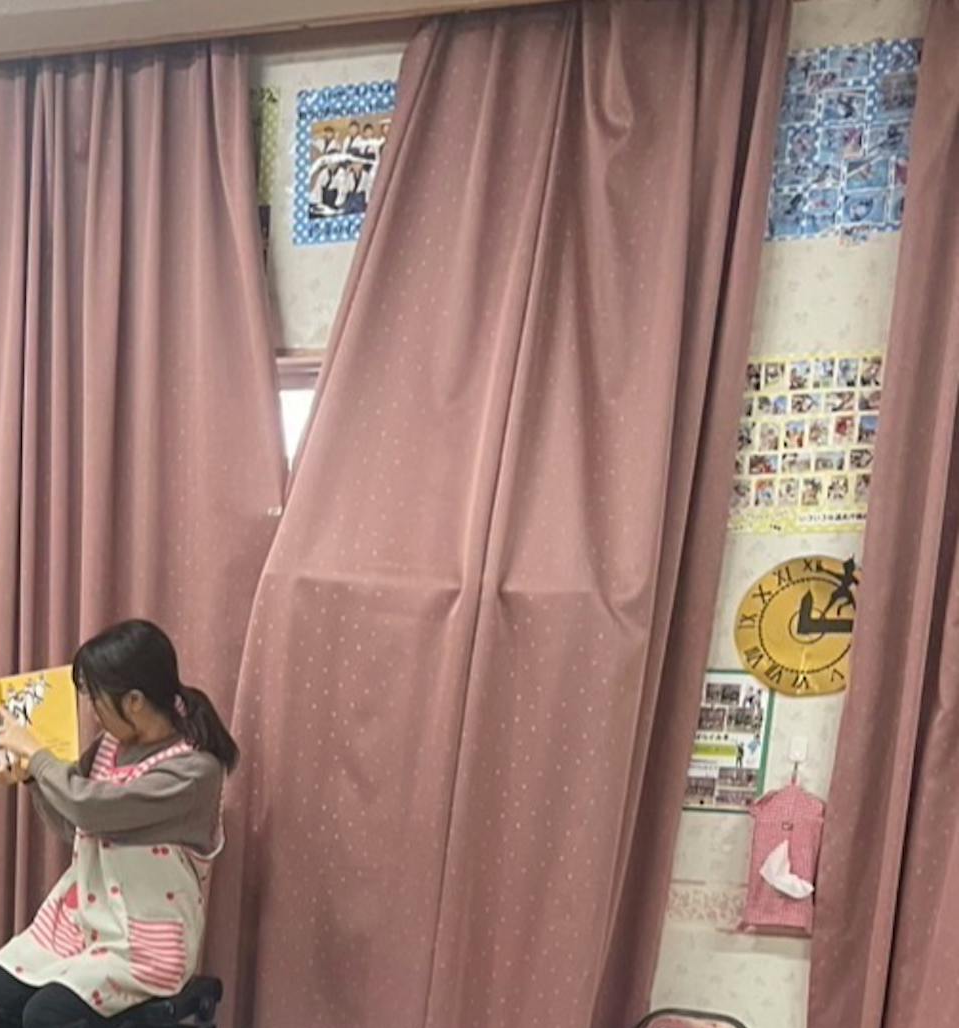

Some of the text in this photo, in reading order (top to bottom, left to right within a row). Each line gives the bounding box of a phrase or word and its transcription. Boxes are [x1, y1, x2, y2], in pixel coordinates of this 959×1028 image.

[774, 566, 792, 586] XI
[752, 585, 772, 604] X
[738, 614, 757, 629] IX
[792, 672, 810, 690] VI
